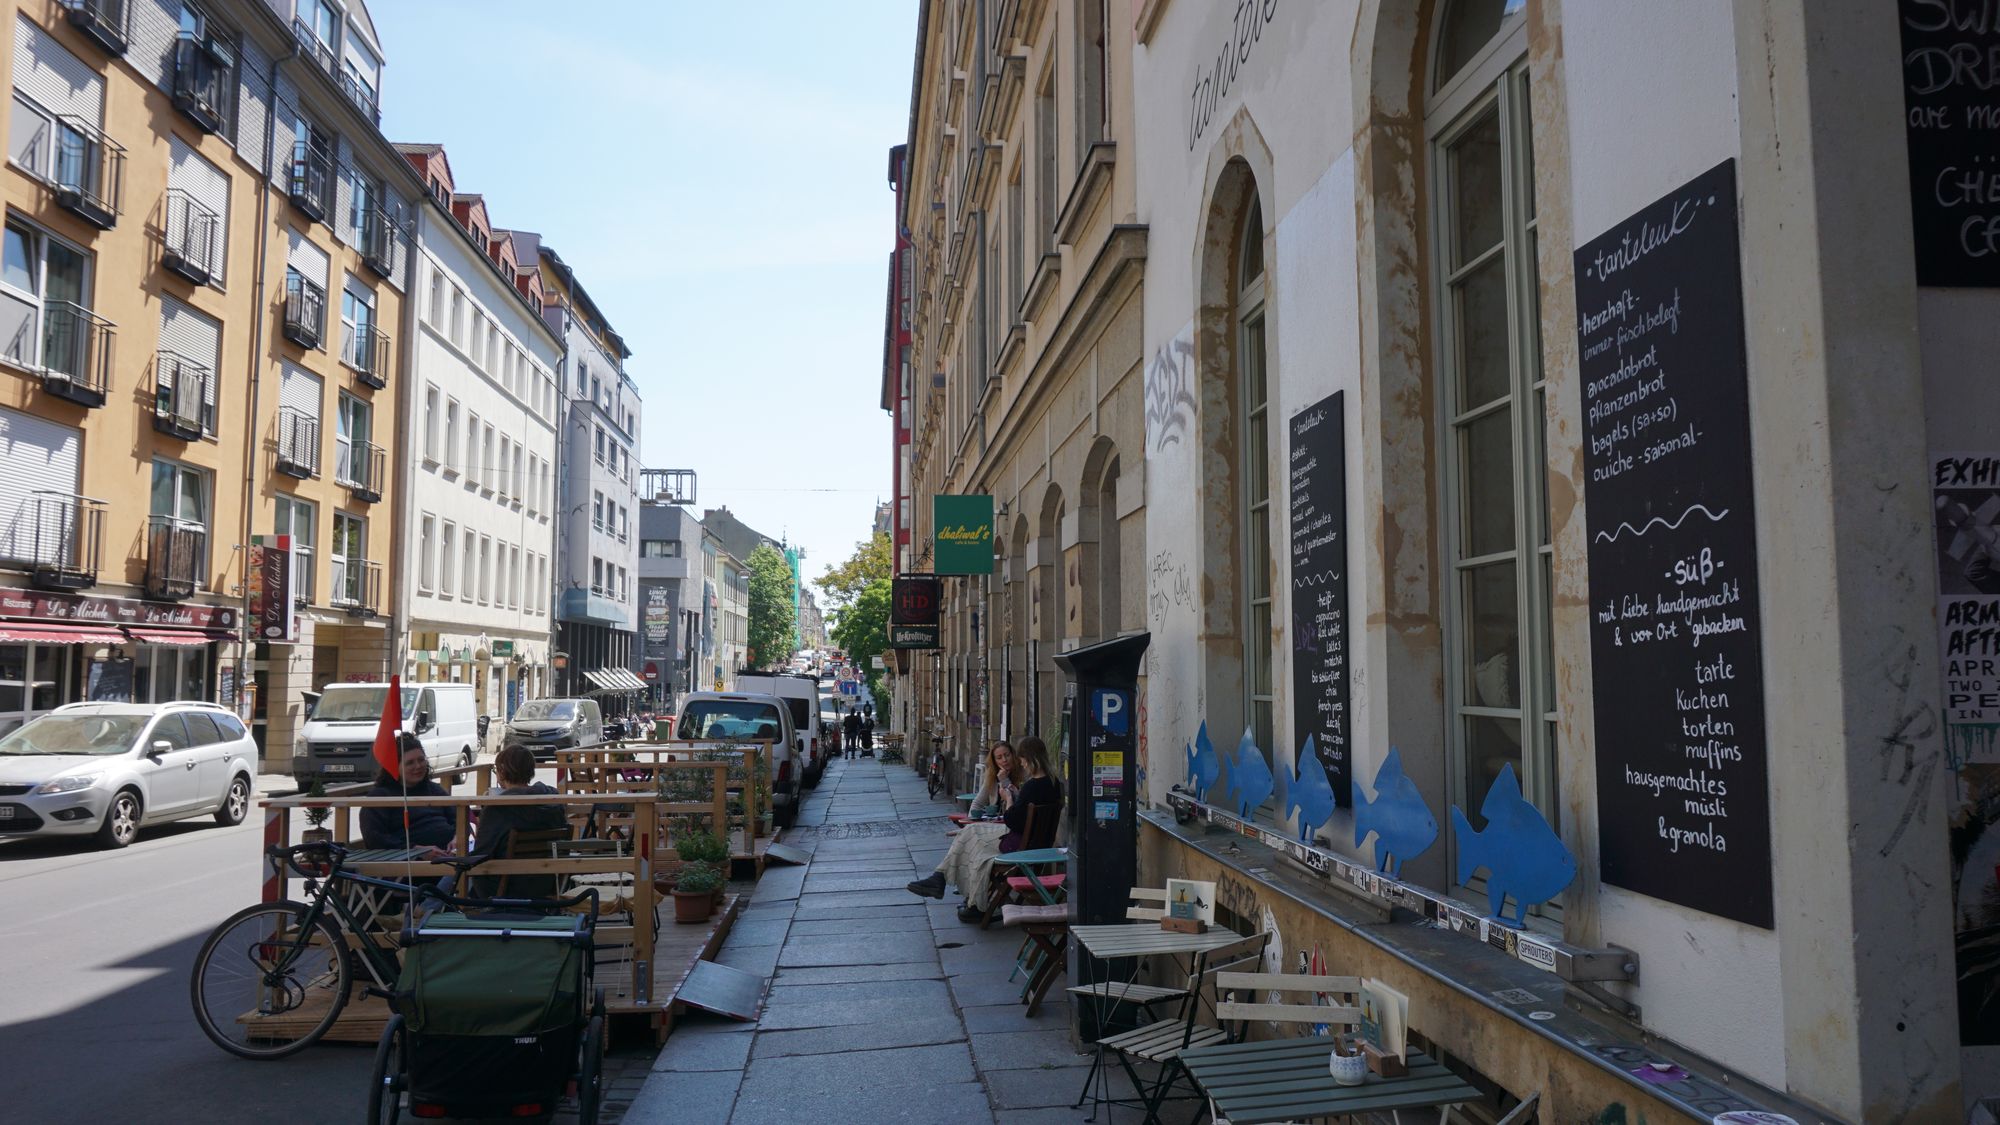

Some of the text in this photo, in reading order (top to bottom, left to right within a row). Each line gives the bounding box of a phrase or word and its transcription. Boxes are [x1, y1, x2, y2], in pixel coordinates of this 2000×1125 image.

[1908, 104, 1952, 129] are
[1584, 337, 1614, 360] immer
[1587, 344, 1658, 399] avocadobrot
[1592, 420, 1629, 457] bagels
[1599, 578, 1741, 626] mit Liebe handgemacht
[1614, 613, 1747, 648] & vor Ort gebacken
[1695, 653, 1736, 684] tarte
[1948, 681, 1983, 692] TWO
[1101, 692, 1123, 726] P
[1958, 710, 1987, 720] IN
[1682, 714, 1735, 738] torten
[1685, 740, 1742, 770] muffins
[1626, 763, 1728, 797] hausgemachtes
[1684, 798, 1728, 818] müsli
[1520, 942, 1554, 963] SPROUTERS
